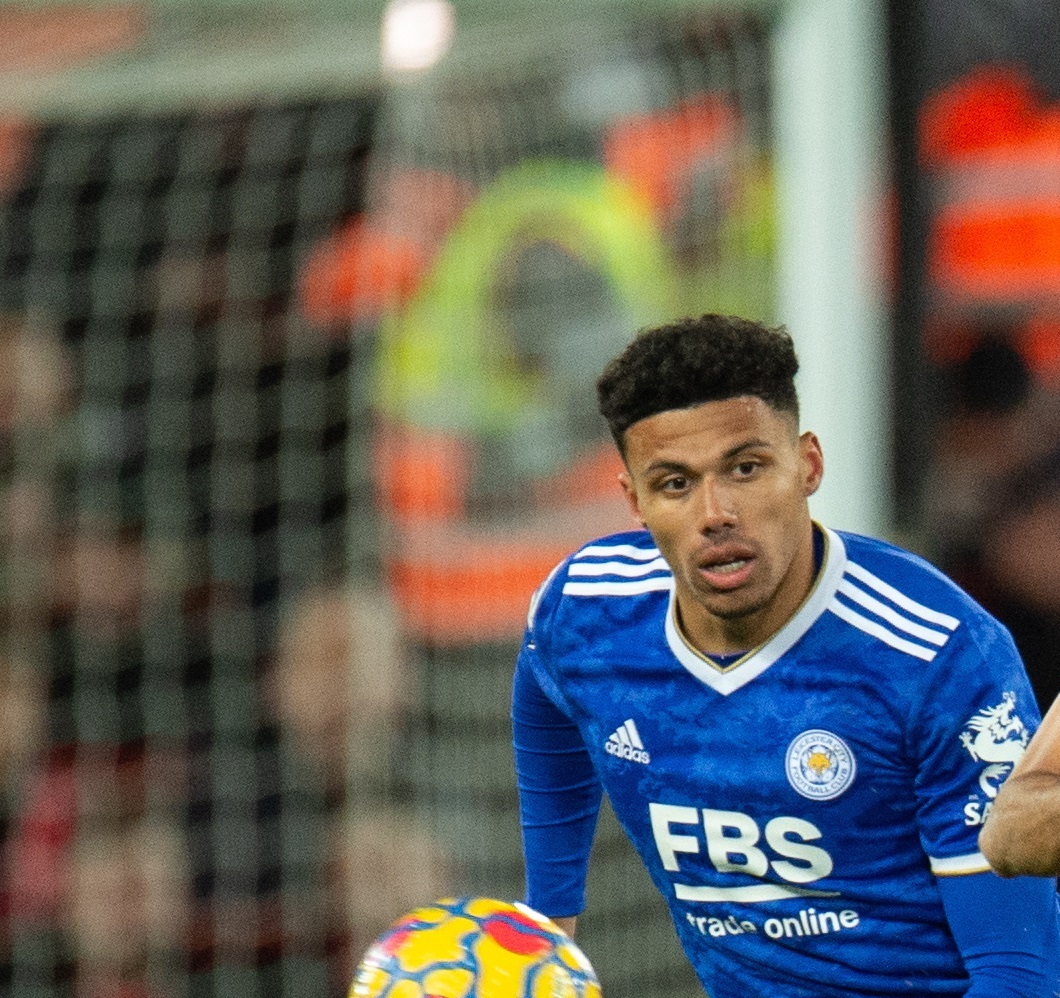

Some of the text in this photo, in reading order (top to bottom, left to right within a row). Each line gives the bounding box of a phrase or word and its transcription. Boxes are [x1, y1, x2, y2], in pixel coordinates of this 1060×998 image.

[604, 740, 651, 766] adidas
[648, 802, 834, 884] FBS
[764, 908, 860, 939] online
